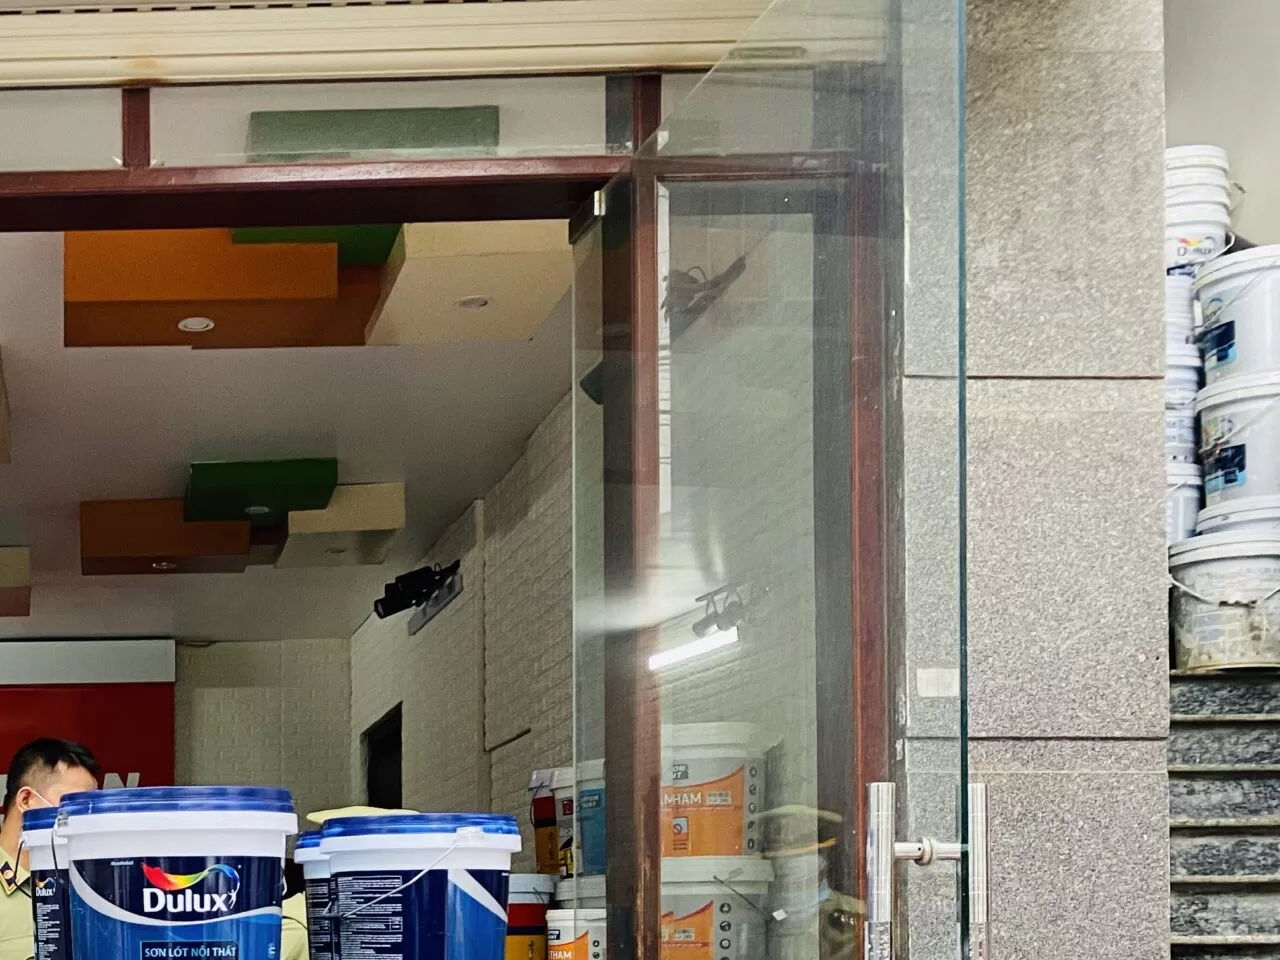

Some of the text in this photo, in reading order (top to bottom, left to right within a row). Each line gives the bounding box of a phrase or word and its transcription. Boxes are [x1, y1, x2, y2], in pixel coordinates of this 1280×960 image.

[142, 888, 228, 913] Dulux
[144, 943, 237, 960] SƠN LÓT NỘI THẤT
